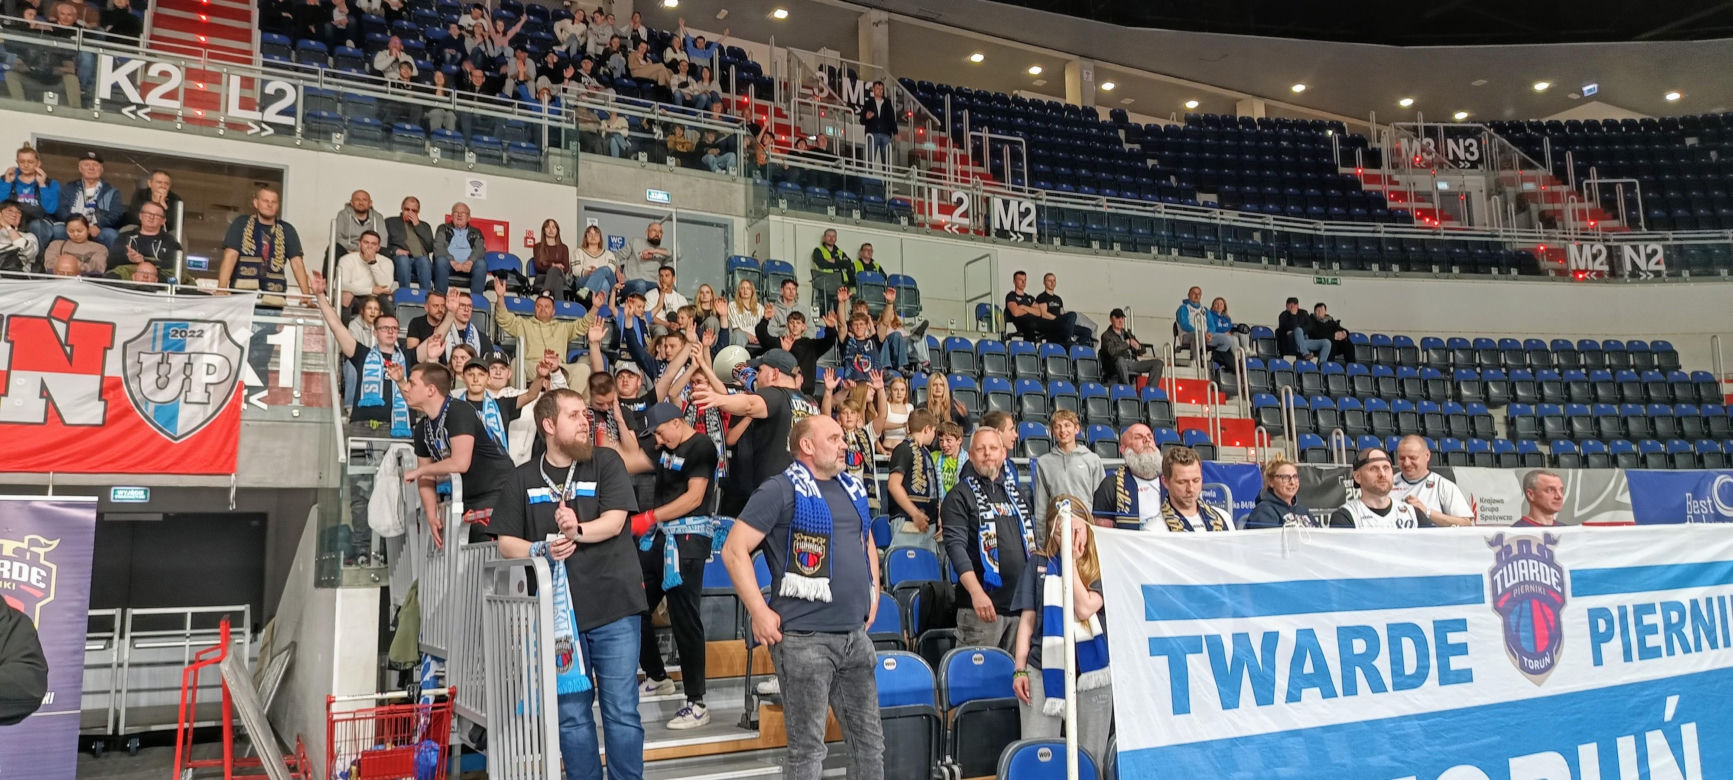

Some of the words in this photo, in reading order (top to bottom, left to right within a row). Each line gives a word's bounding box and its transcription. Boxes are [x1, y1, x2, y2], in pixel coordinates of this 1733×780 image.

[99, 55, 183, 109] K2
[227, 74, 297, 126] L2
[1446, 138, 1480, 161] N3
[931, 188, 970, 225] L2
[993, 197, 1037, 234] M2
[610, 235, 623, 244] WC
[1568, 243, 1610, 271] M2
[1623, 243, 1666, 272] N2
[169, 327, 205, 339] 2022
[0, 295, 117, 427] Ń
[137, 351, 232, 404] UP
[1480, 496, 1504, 505] Krajowa
[1480, 505, 1499, 513] Grupa
[1686, 492, 1714, 514] Best
[1493, 559, 1562, 596] TWARDE
[1512, 584, 1546, 598] PIERNIKI
[1587, 594, 1733, 667] PIERNI
[1149, 617, 1475, 717] TWARDE
[1521, 651, 1551, 671] TORUŃ
